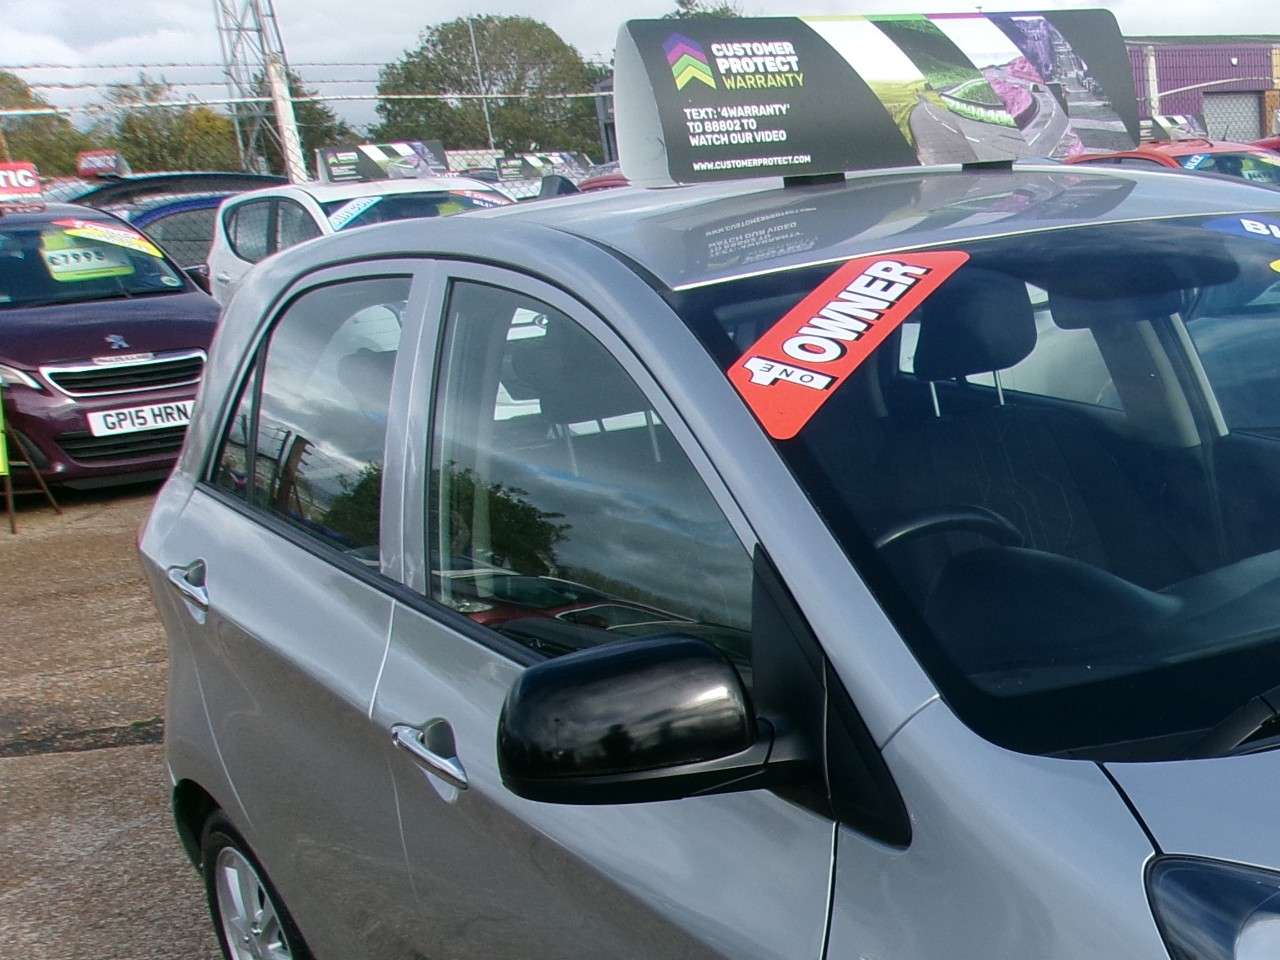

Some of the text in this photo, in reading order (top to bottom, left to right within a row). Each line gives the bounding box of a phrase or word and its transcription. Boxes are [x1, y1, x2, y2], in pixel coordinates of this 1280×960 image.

[711, 41, 796, 57] CUSTOMER
[716, 56, 799, 74] PROTECT
[722, 73, 804, 90] WARRANTY
[683, 103, 790, 120] TEXT: '4WARRANTY'
[687, 118, 757, 133] TO 88802 TO
[689, 130, 787, 147] WATCH OUR VIDEO
[693, 155, 812, 171] WWW.CUSTOMERPROTECT.COM
[783, 260, 933, 363] OWNER
[760, 363, 815, 384] ONE
[103, 404, 191, 430] GP15 HRN
